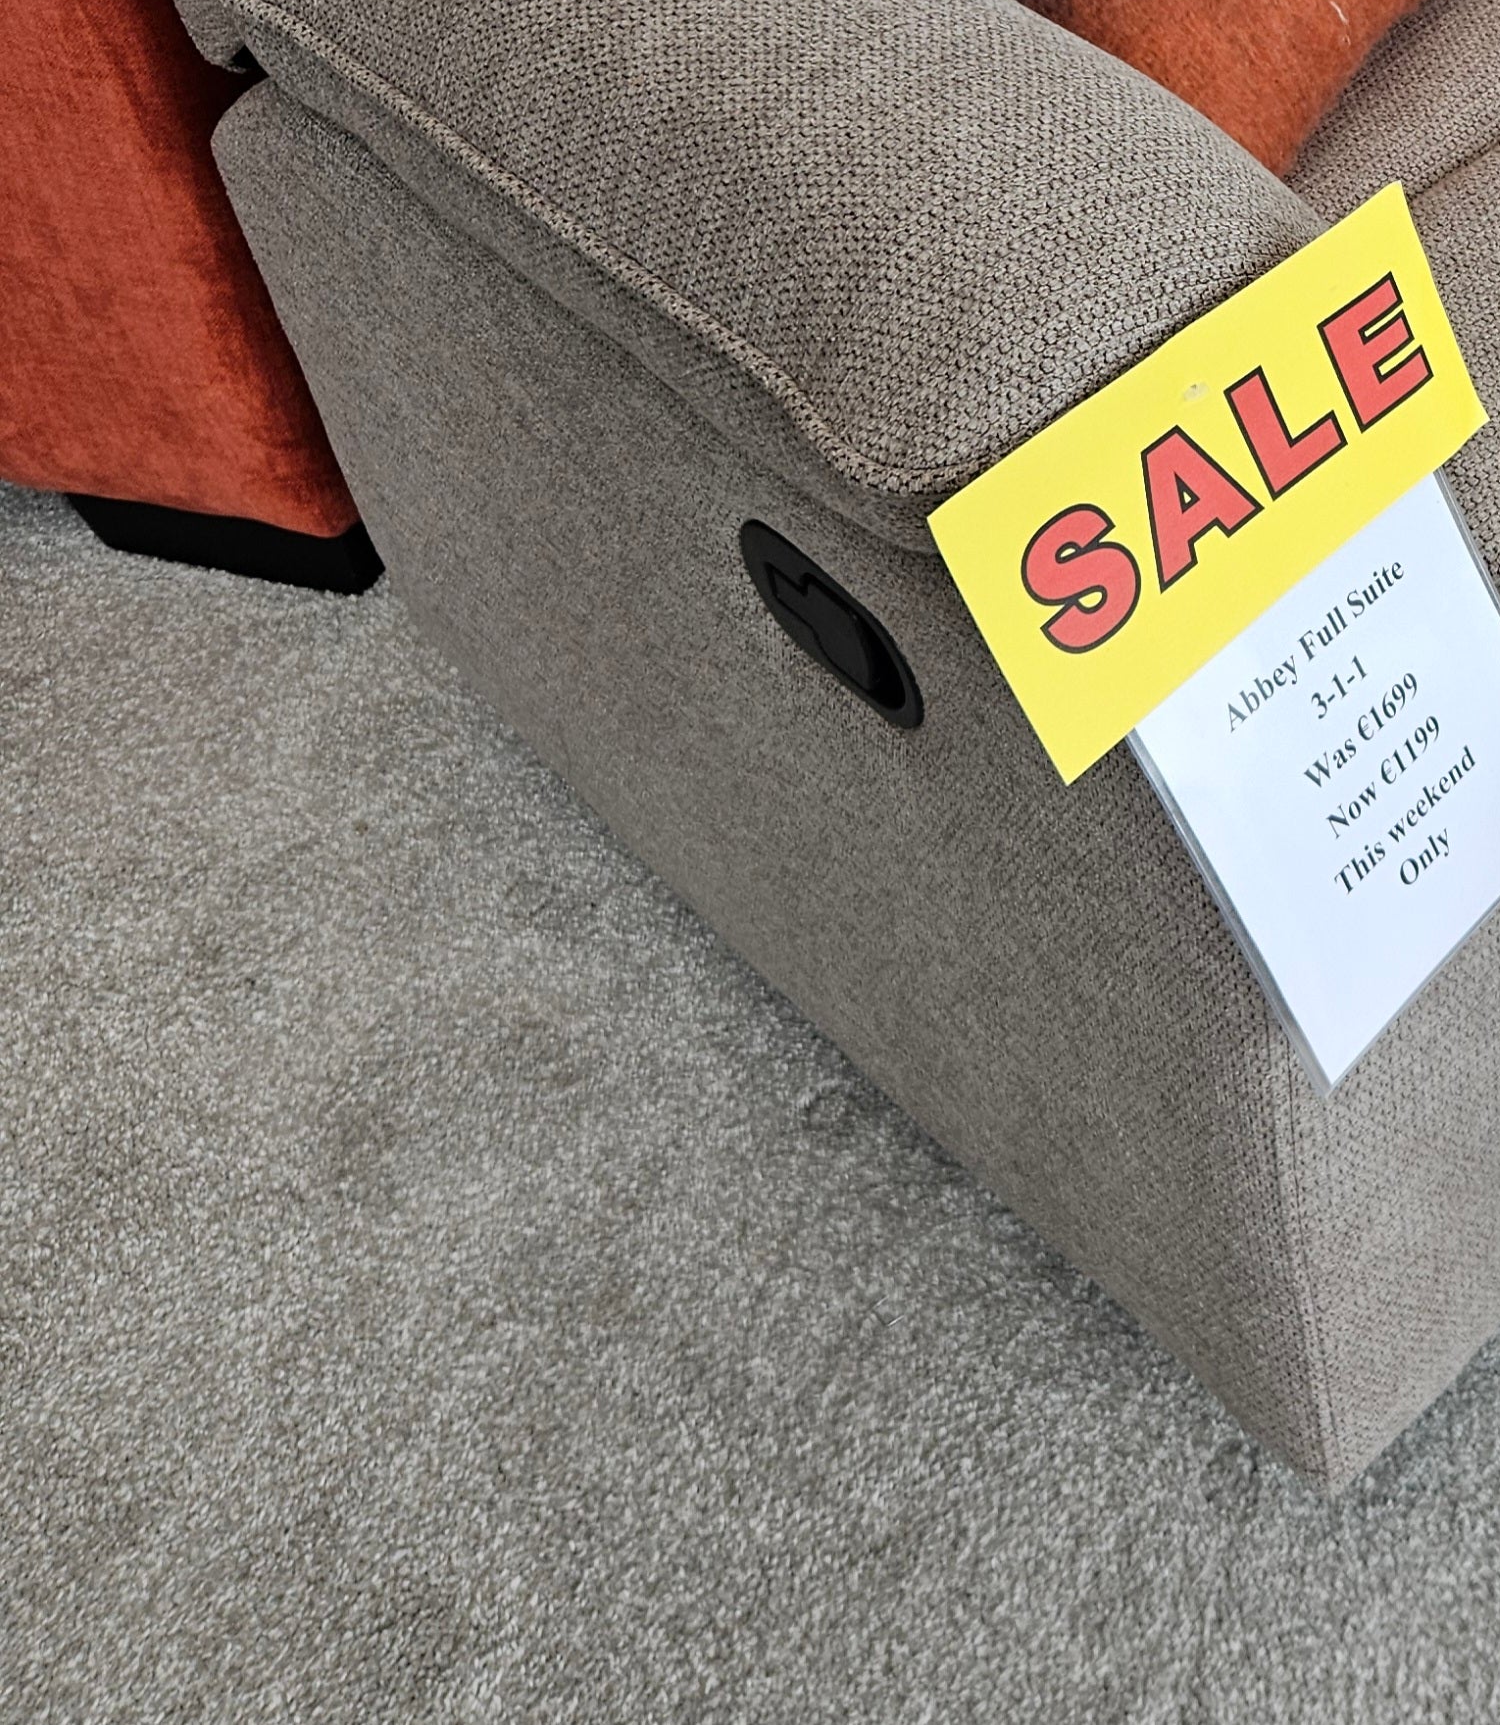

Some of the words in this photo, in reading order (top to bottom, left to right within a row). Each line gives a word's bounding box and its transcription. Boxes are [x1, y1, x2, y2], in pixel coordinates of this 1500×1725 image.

[1021, 271, 1434, 654] SALE
[1226, 655, 1299, 733] Abbey
[1298, 606, 1348, 662] Full
[1346, 560, 1405, 618] Suite
[1310, 655, 1369, 720] 3-1-1
[1303, 737, 1357, 789] Was
[1357, 672, 1419, 742] €1699
[1326, 780, 1377, 839] Now
[1380, 715, 1441, 785] €1199
[1334, 842, 1386, 895] This
[1387, 745, 1476, 844] weekend
[1399, 828, 1450, 886] Only
